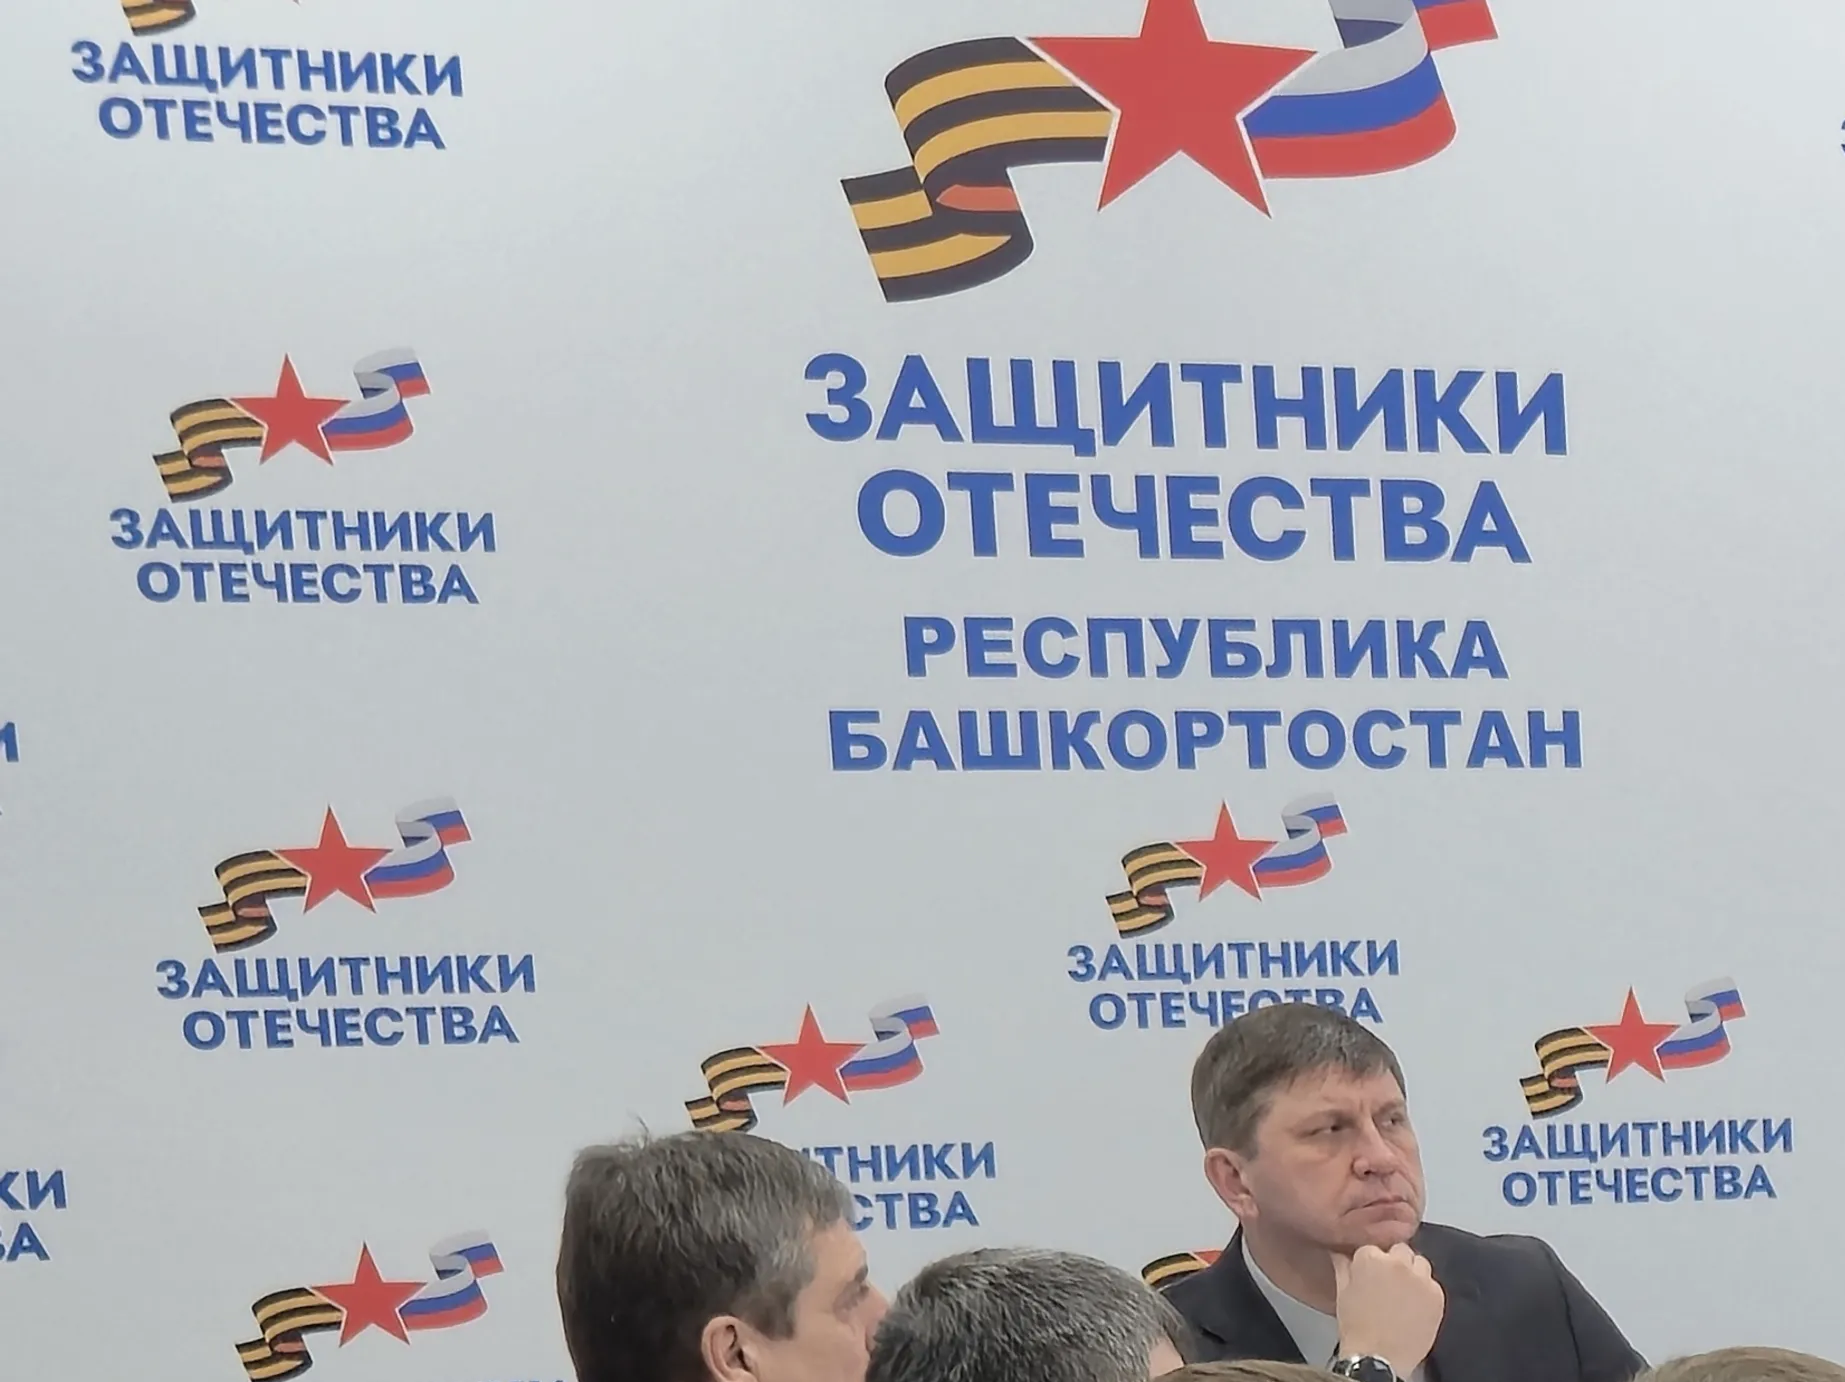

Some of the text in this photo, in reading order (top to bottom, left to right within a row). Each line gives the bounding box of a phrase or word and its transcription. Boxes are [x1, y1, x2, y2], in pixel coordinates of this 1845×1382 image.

[70, 38, 464, 99] ЗАЩИТНИКИ
[96, 95, 446, 151] ОТЕЧЕСТВА
[804, 351, 1569, 459] ЗАЩИТНИКИ
[111, 506, 497, 556] ЗАЩИТНИКИ
[855, 467, 1531, 565] ОТЕЧЕСТВА
[135, 560, 478, 606] ОТЕЧЕСТВА
[902, 614, 1509, 681] РЕСПУБЛИКА
[827, 707, 1584, 773] БАШКОРТОСТАН
[158, 952, 537, 1002] ЗАЩИТНИКИ
[1065, 938, 1401, 987] ЗАЩИТНИКИ
[181, 1004, 517, 1051] ОТЕЧЕСТВА
[799, 1140, 998, 1183] ТНИКИ
[1486, 1117, 1794, 1163] ЗАЩИТНИКИ
[1501, 1163, 1775, 1208] ОТЕЧЕСТВА
